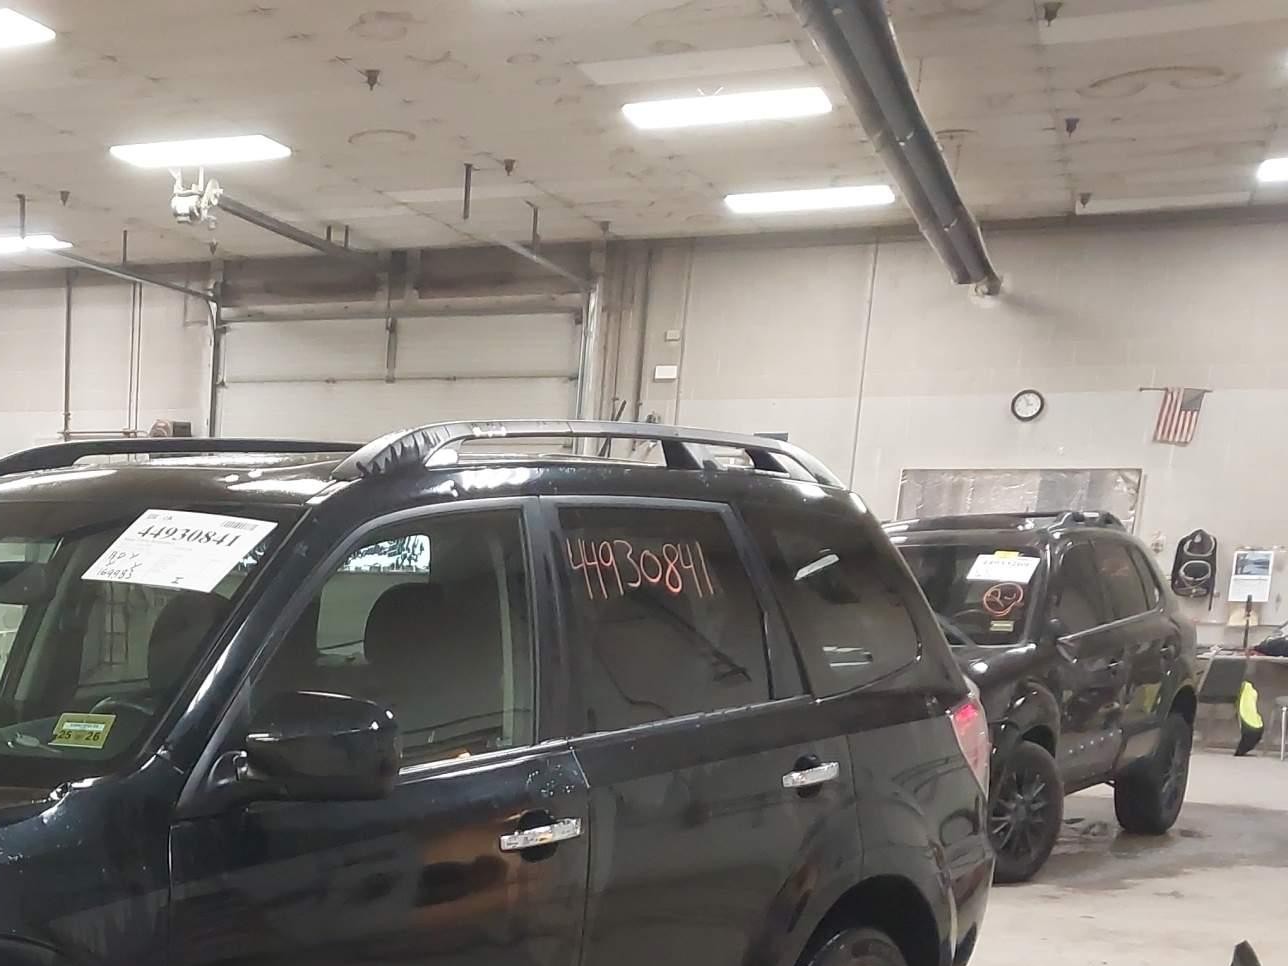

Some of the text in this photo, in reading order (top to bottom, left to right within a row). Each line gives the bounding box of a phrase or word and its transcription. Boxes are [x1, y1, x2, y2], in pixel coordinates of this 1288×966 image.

[138, 525, 242, 547] 44930841
[566, 537, 714, 600] 44930841
[57, 729, 101, 742] 25 26
